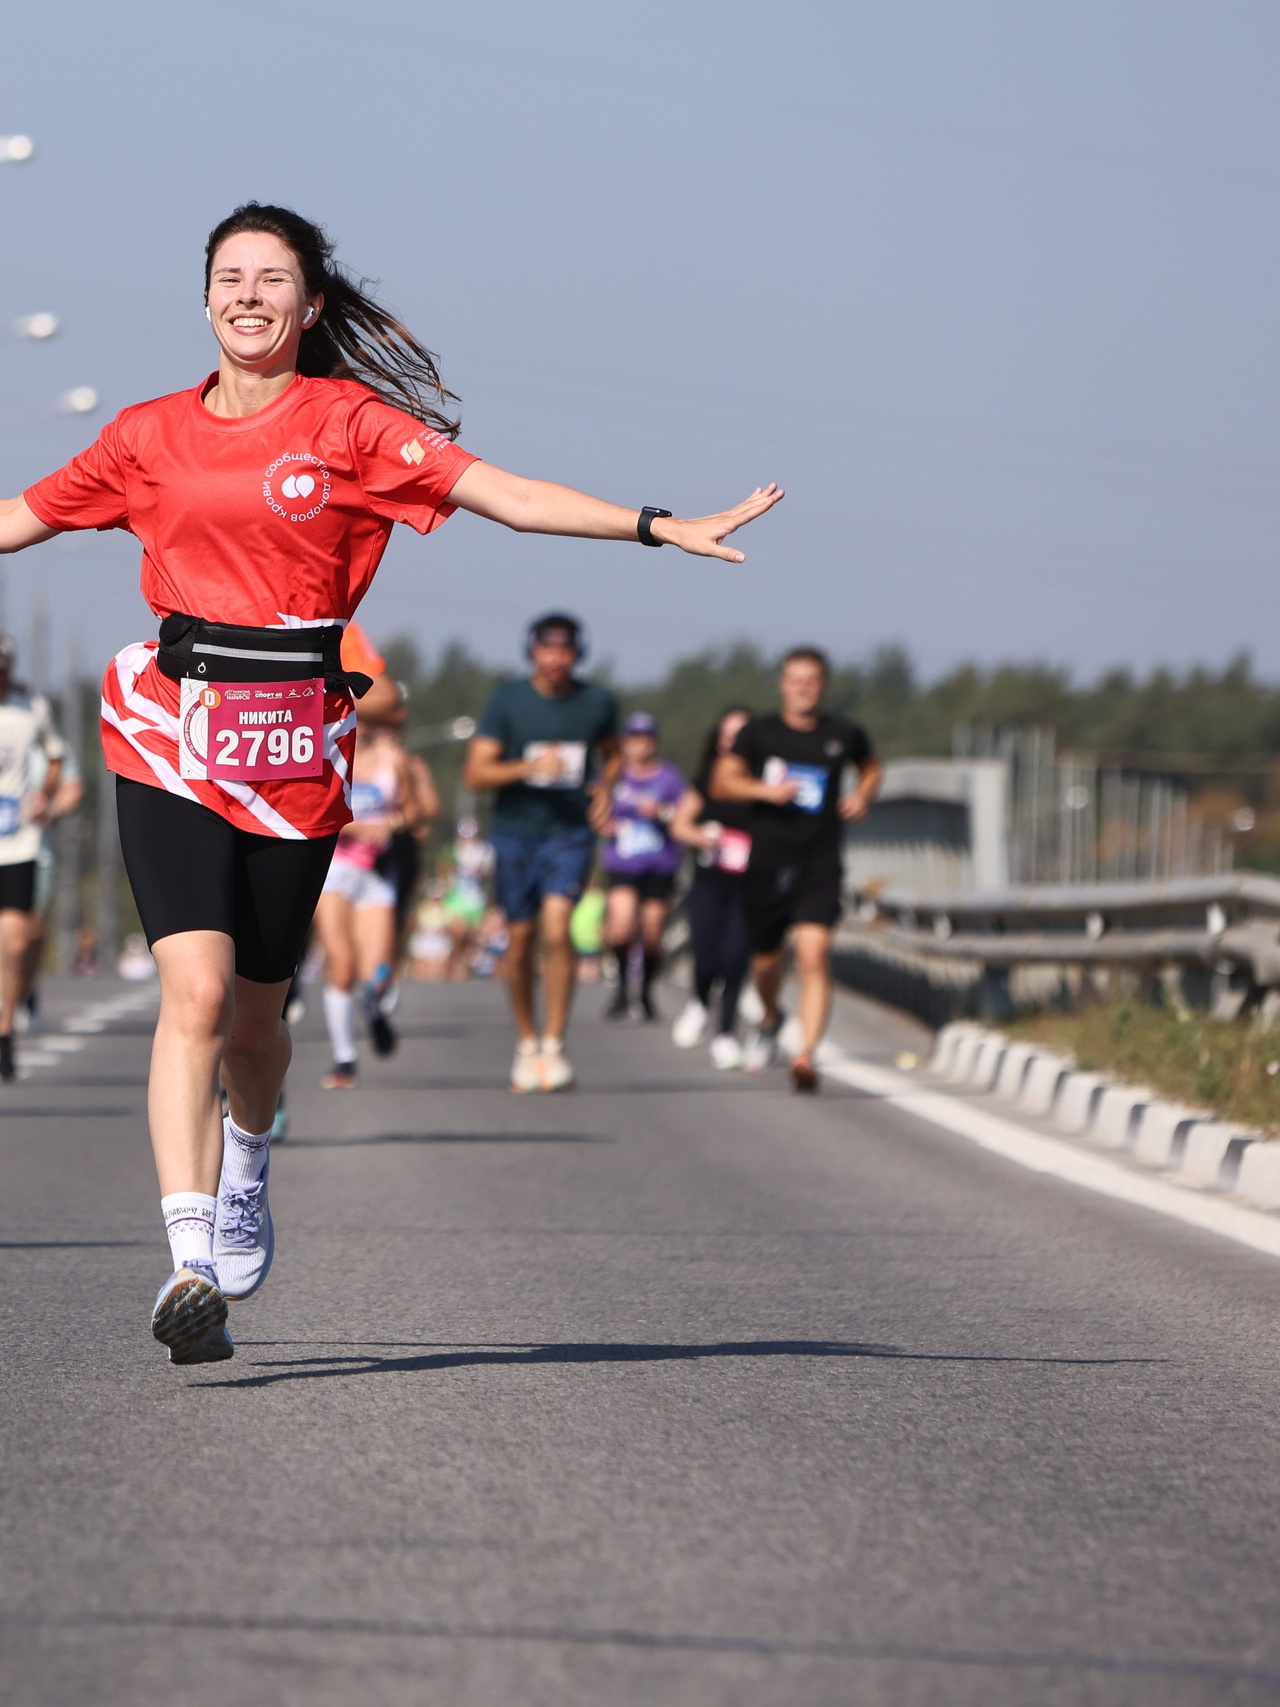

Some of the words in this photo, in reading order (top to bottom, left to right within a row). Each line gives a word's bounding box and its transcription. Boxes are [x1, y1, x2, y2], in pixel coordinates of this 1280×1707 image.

[265, 452, 329, 479] сообщество
[263, 481, 287, 519] крови
[290, 482, 331, 522] доноров
[204, 690, 216, 706] D
[238, 709, 293, 725] НИКИТА
[215, 725, 314, 767] 2796
